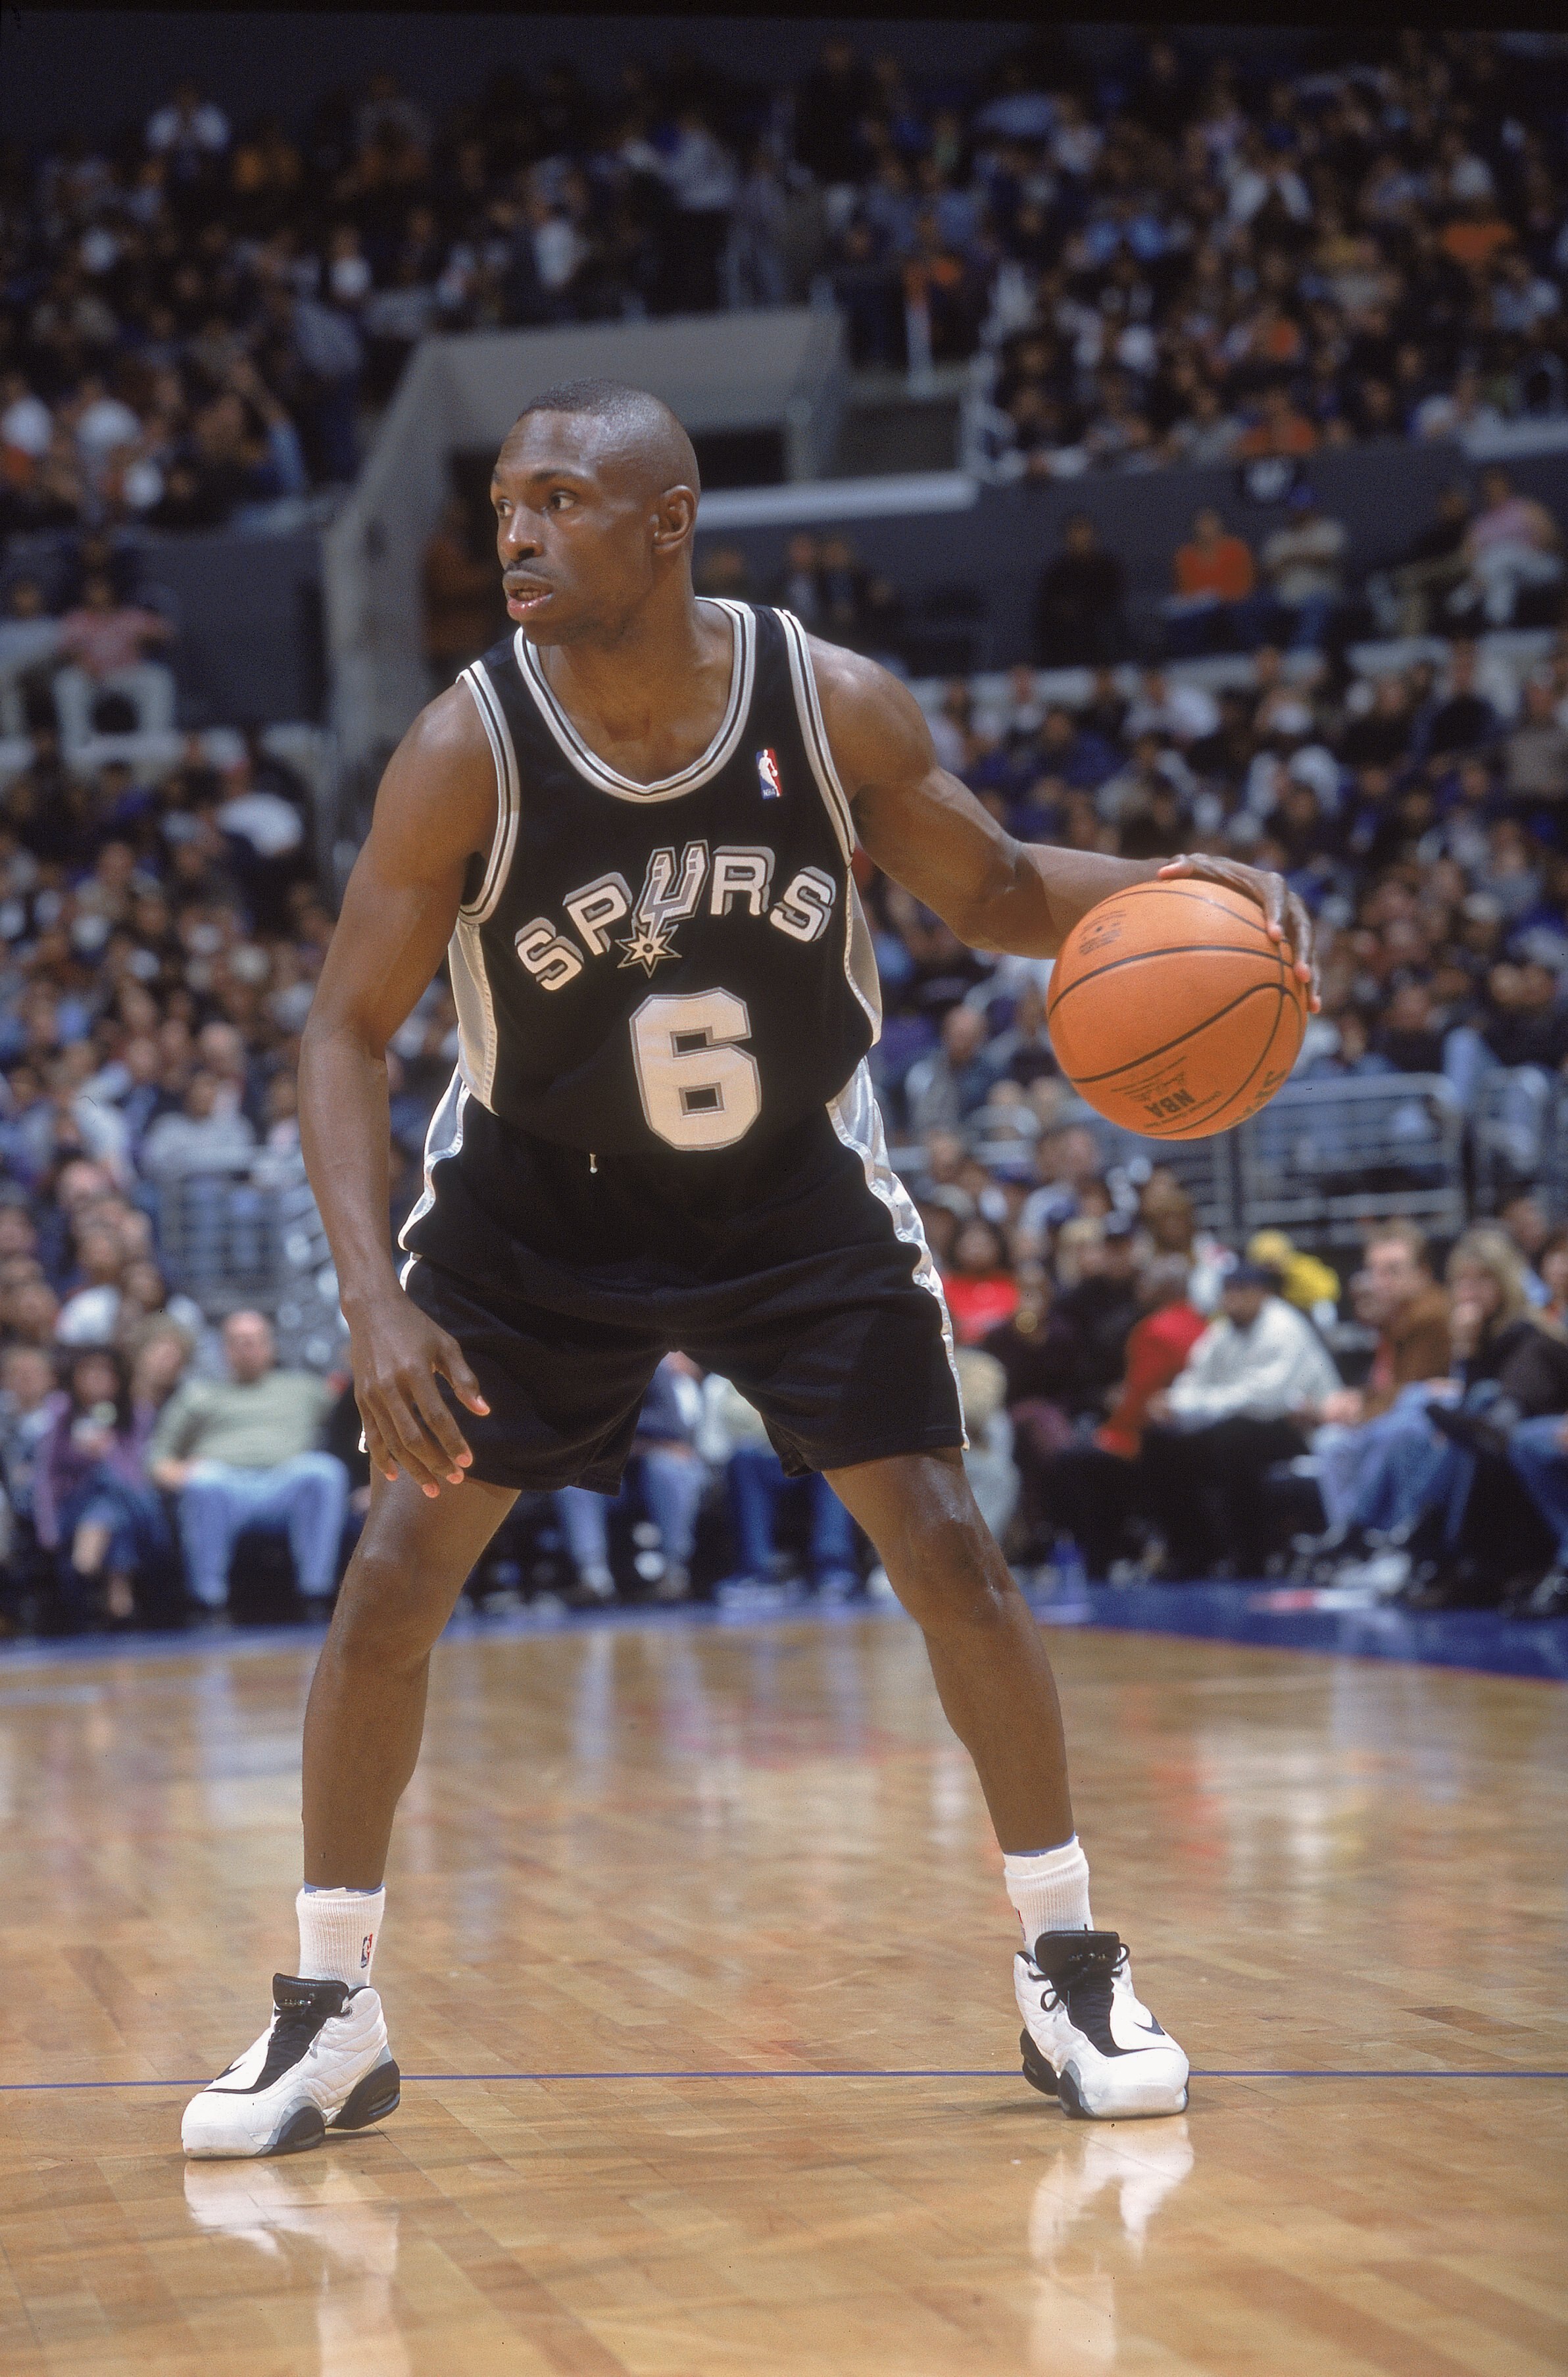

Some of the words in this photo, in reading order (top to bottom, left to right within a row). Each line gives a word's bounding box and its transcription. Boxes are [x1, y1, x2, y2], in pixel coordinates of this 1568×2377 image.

[515, 839, 836, 991] SPURS
[629, 987, 762, 1151] 6
[1144, 1089, 1196, 1117] NBA
